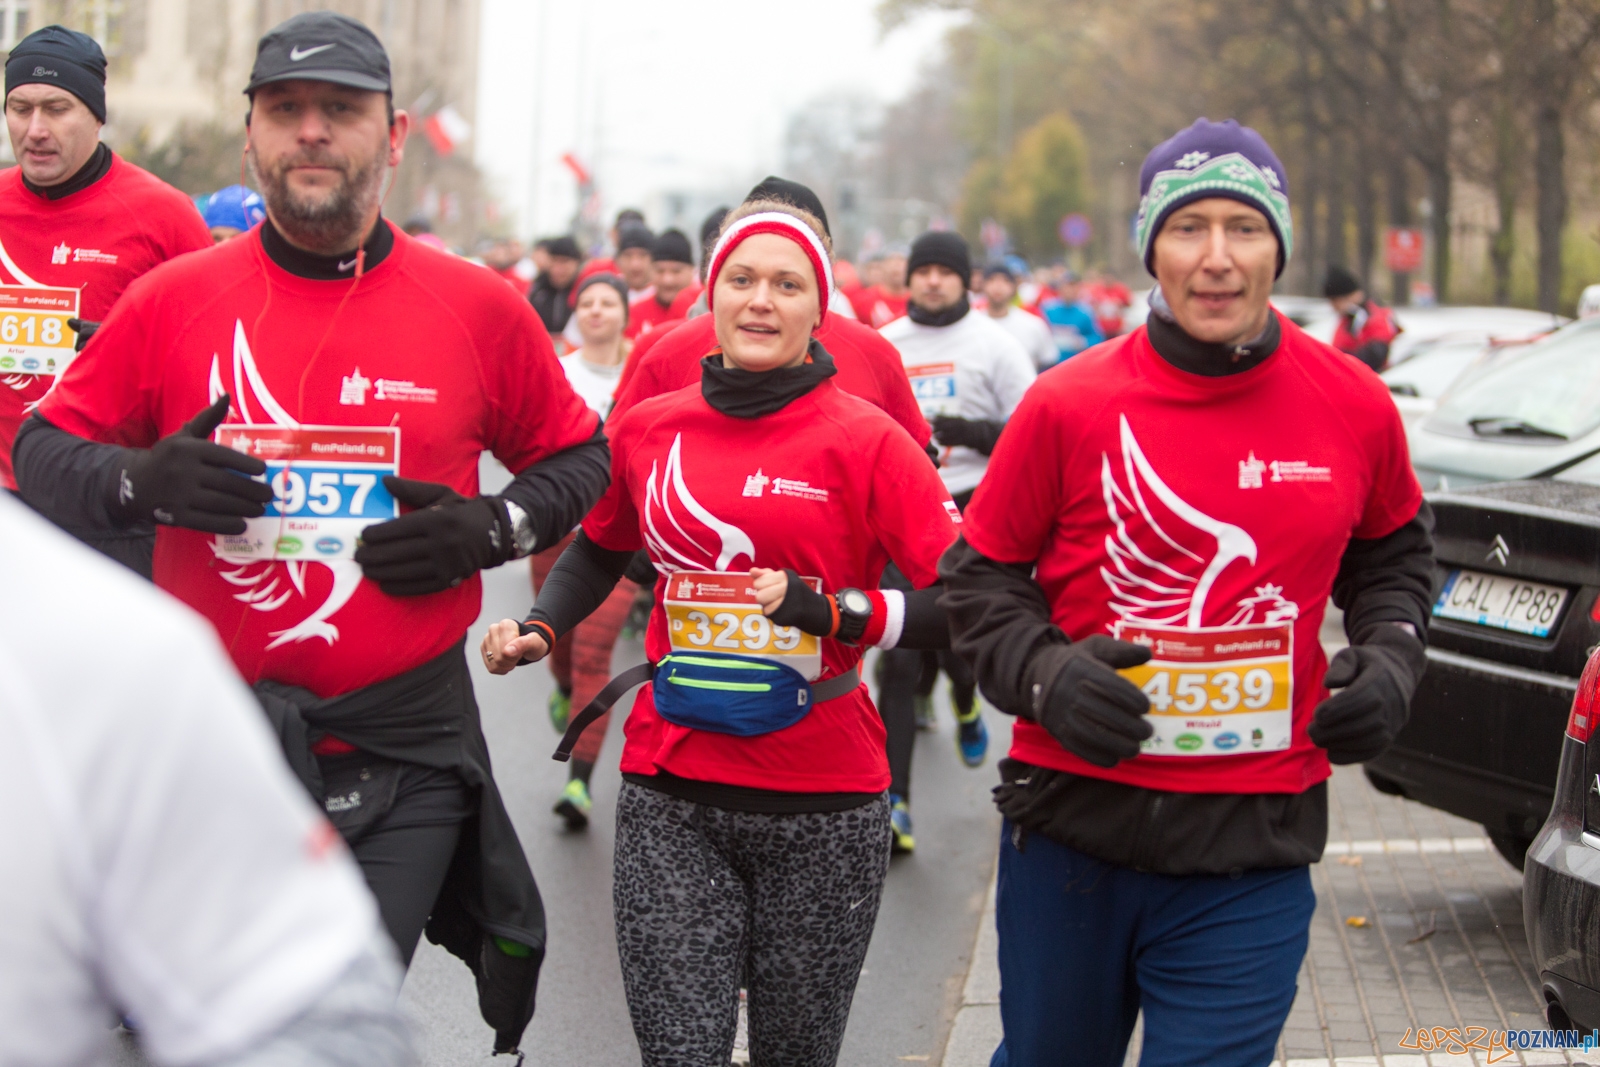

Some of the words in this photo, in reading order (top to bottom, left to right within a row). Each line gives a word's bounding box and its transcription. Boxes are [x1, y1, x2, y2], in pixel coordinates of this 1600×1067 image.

[23, 296, 70, 308] RunPoland.org
[311, 442, 385, 457] RunPoland.org
[252, 471, 377, 515] 957
[1452, 575, 1494, 612] CAL
[1502, 583, 1560, 624] 1P88
[687, 610, 802, 651] 3299
[1214, 639, 1281, 655] RunPoland.org
[1141, 667, 1275, 714] 4539
